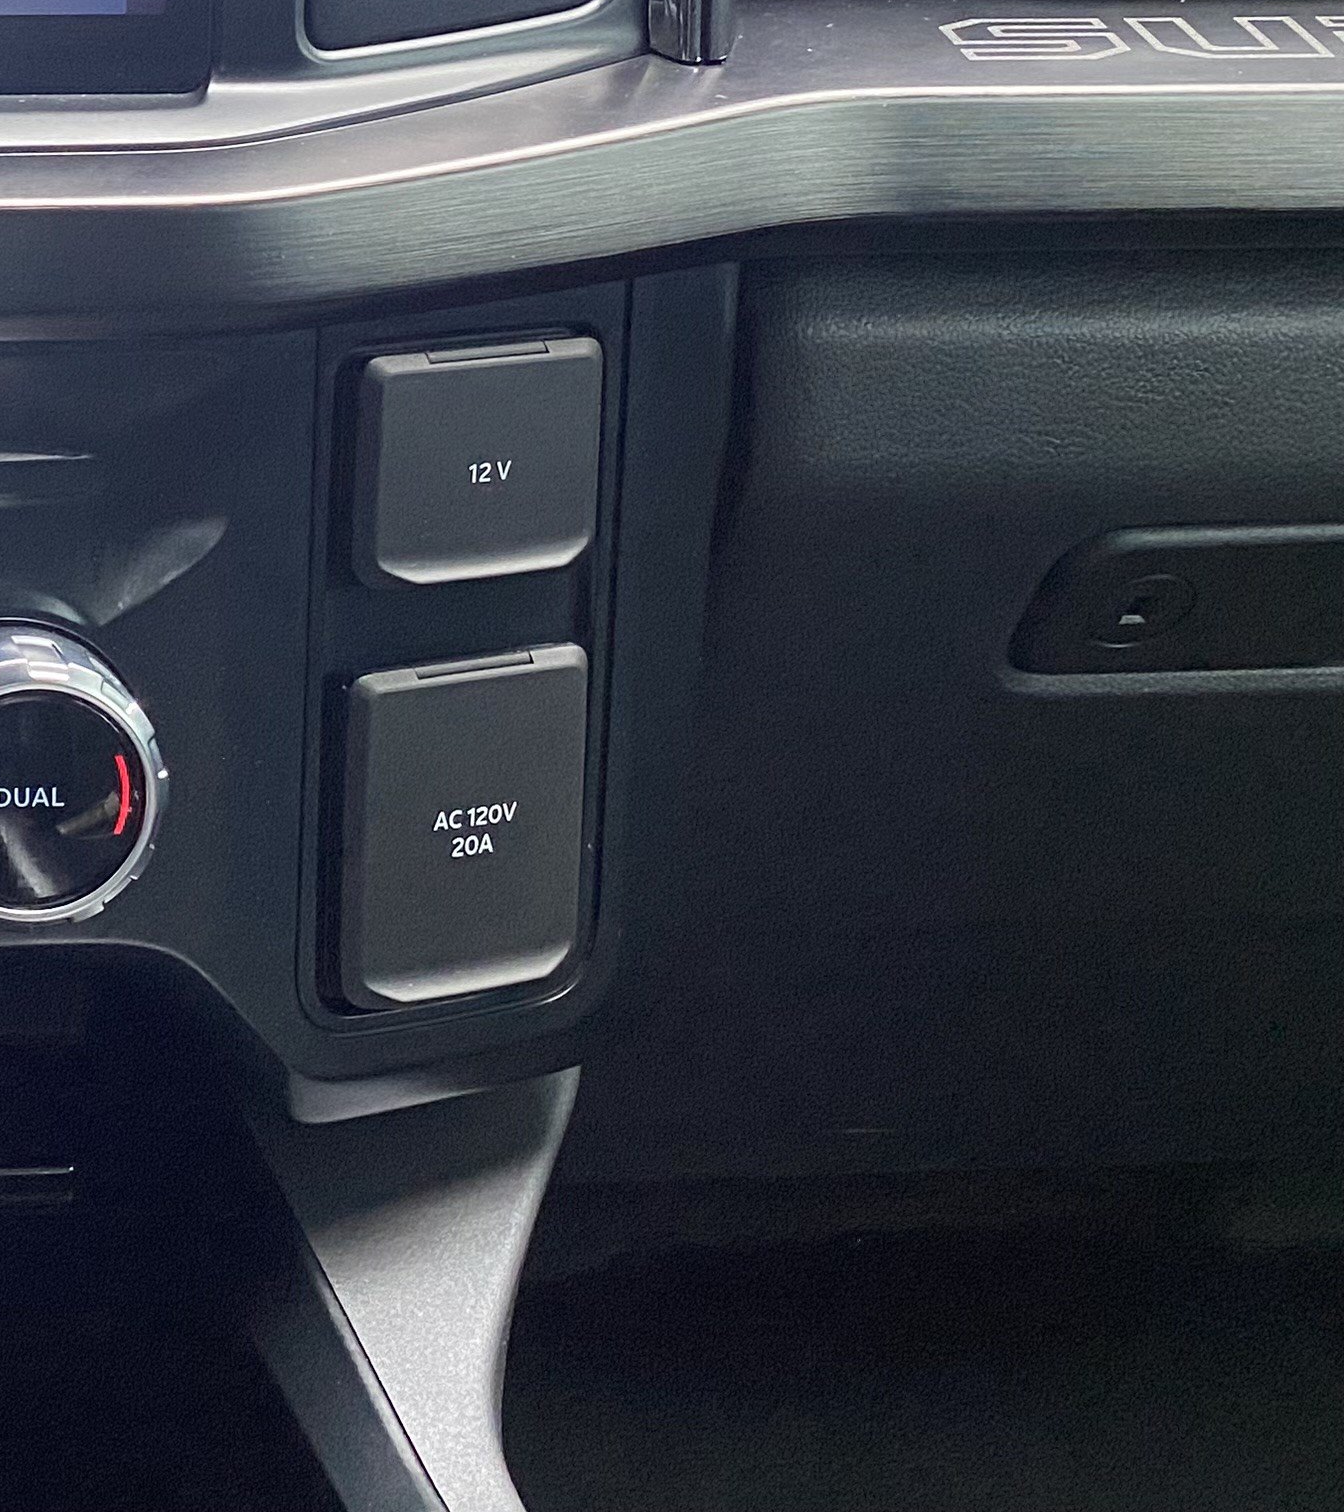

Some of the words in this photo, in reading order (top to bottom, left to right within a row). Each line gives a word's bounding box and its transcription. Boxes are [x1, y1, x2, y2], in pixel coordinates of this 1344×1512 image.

[938, 15, 1344, 62] SU
[468, 461, 492, 484] 12
[495, 459, 512, 481] V
[433, 808, 463, 832] AC
[466, 801, 518, 829] 120V
[451, 833, 494, 858] 20A
